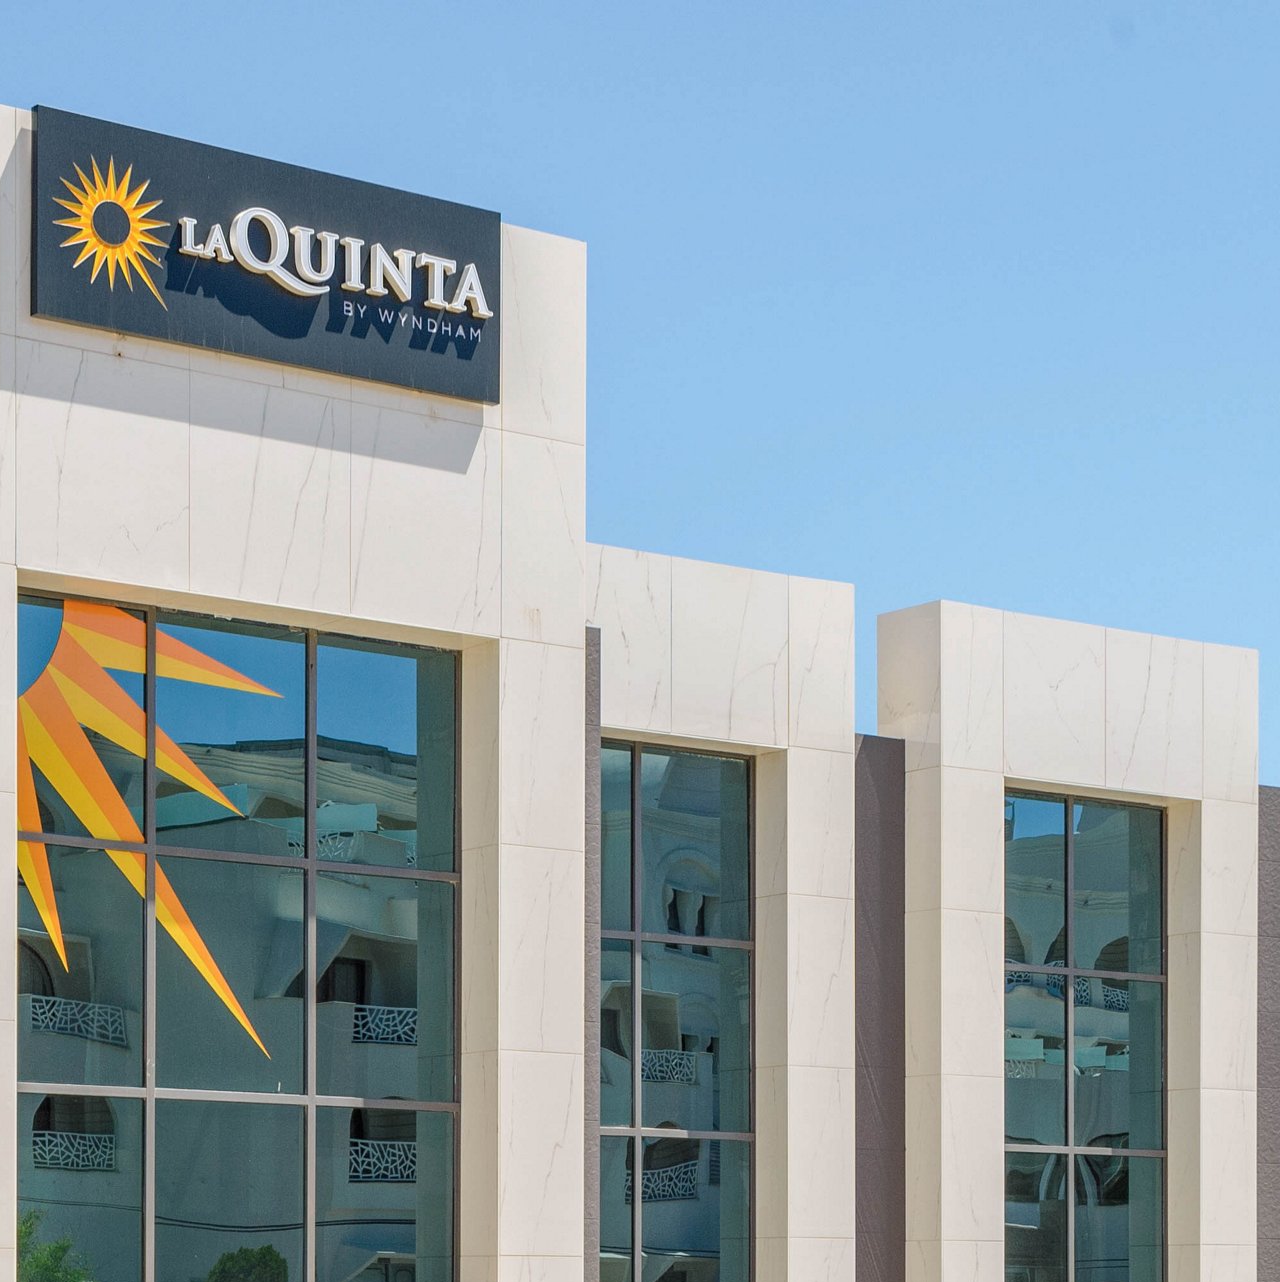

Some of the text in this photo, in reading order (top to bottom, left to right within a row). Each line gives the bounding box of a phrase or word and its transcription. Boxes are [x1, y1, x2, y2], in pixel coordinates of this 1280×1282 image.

[229, 206, 494, 319] QUINTA
[343, 300, 482, 343] BY WYNDHAM
